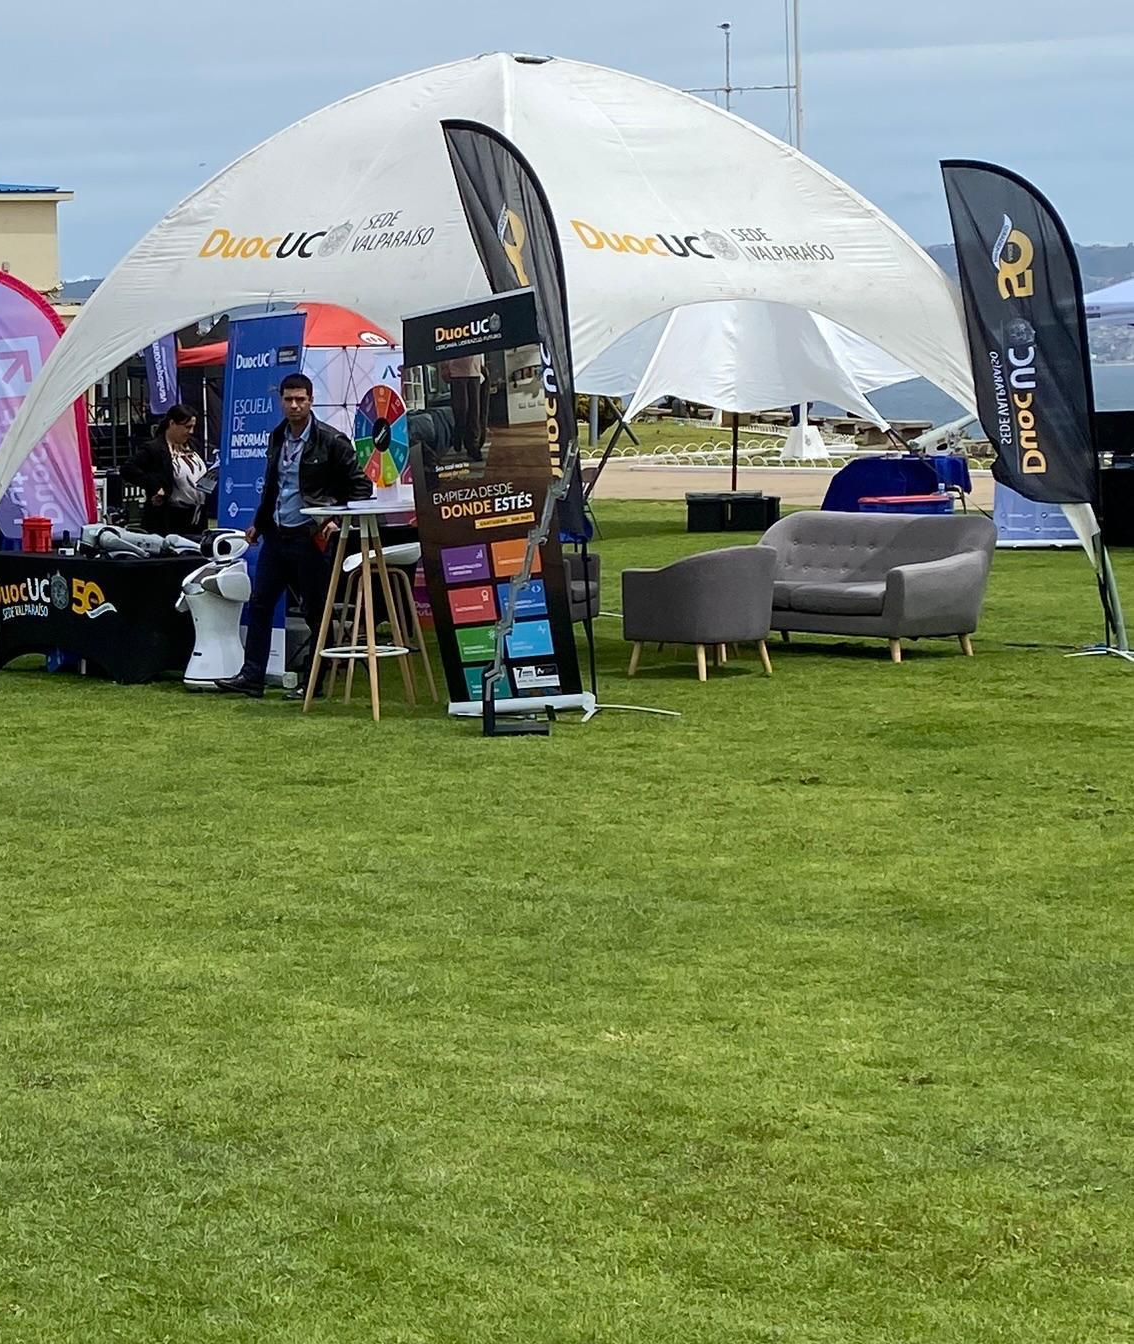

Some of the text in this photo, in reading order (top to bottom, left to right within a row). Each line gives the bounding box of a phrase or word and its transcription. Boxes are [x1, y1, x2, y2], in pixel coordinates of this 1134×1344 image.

[363, 210, 403, 231] SEDE
[352, 224, 435, 253] VALPARAÍSO
[731, 228, 772, 242] SEDE
[745, 242, 835, 261] VALPARAÍSO
[234, 397, 273, 416] ESCUELA
[232, 416, 246, 432] DE
[231, 430, 271, 447] INFORMÁT
[231, 448, 268, 459] TELECOMUNIC
[432, 482, 514, 505] EMPIEZA DESDE
[441, 491, 533, 519] DONDE ESTÉS
